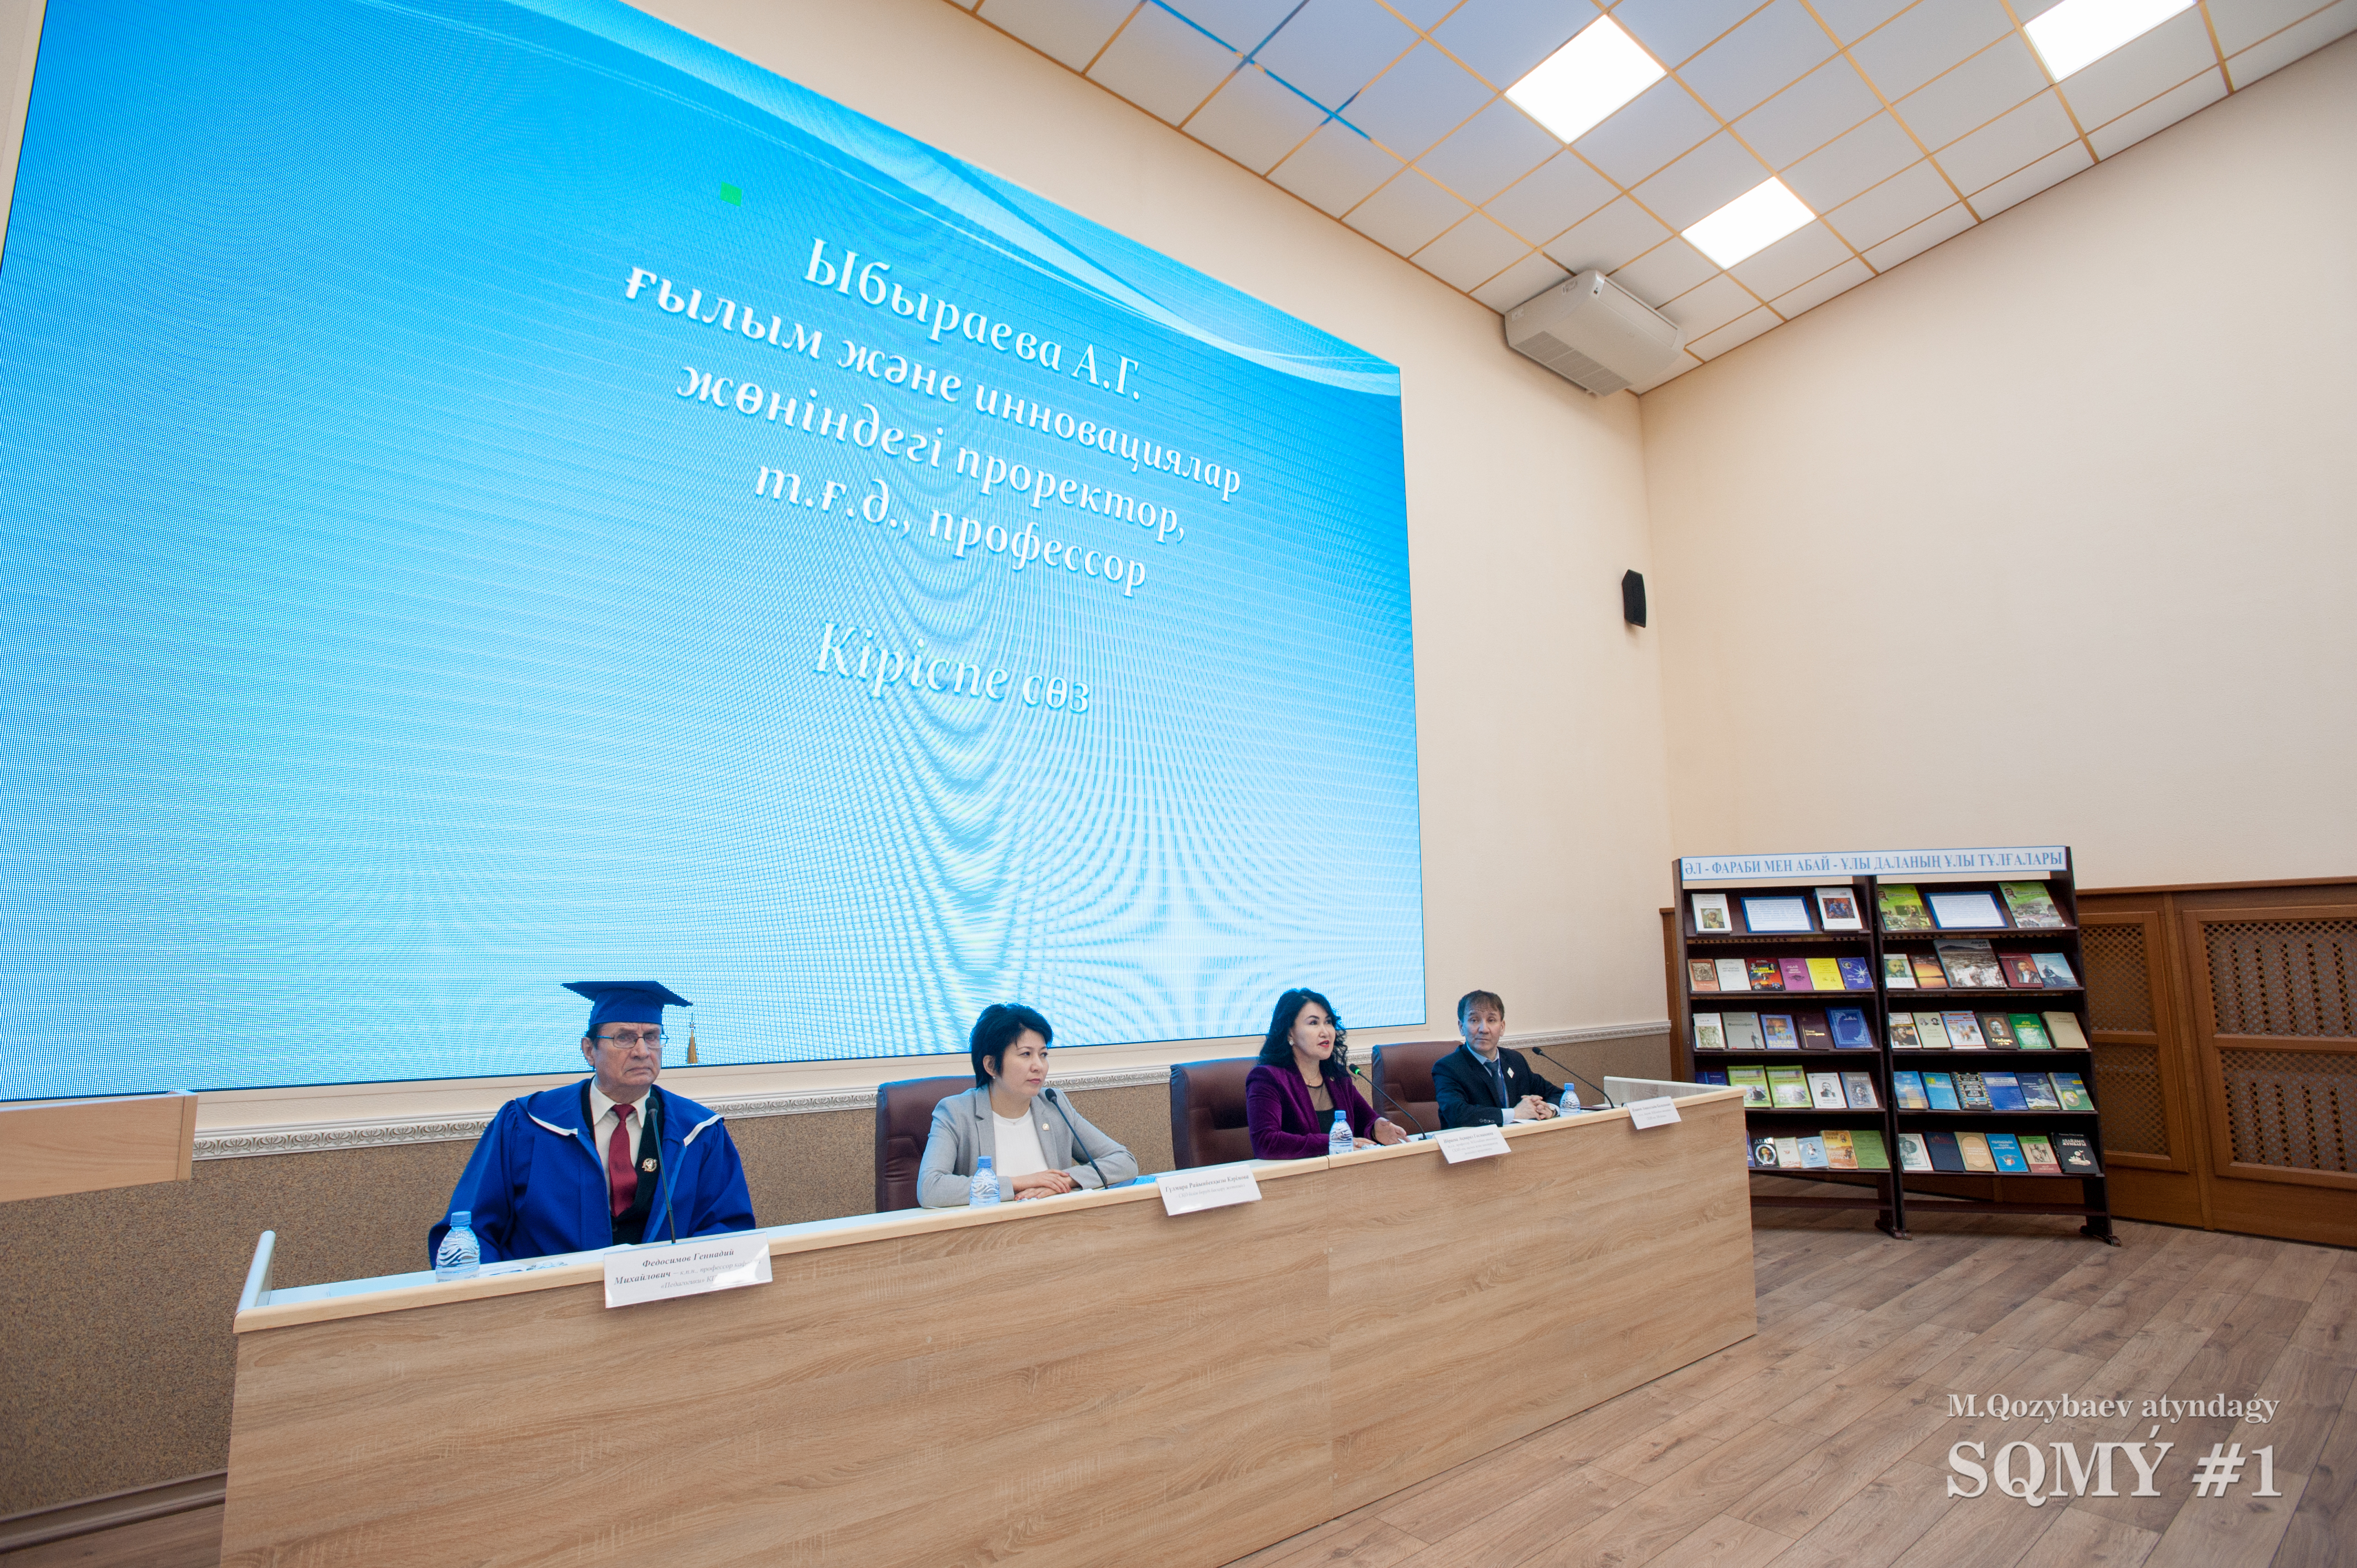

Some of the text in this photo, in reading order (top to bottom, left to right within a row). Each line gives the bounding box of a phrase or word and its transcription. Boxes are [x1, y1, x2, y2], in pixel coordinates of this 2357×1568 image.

[804, 237, 1141, 400] Ыбыраева А.Г.
[625, 267, 1241, 502] ғылым және инновациялар
[676, 367, 1185, 543] жөніндегі проректор,
[755, 466, 1146, 597] т.ғ.д., профессор
[814, 622, 1090, 714] Кіріспе сөз
[1685, 863, 1702, 875] ӘЛ
[1712, 860, 1761, 874] ФАРАБИ
[1764, 860, 1792, 873] МЕН
[1796, 856, 1830, 871] АБАЙ
[1841, 857, 1871, 870] ҰЛЫ
[1874, 855, 1942, 871] ДАЛАНЫҢ
[1944, 854, 1975, 868] ҰЛЫ
[1978, 852, 2062, 867] ТҰЛҒАЛАРЫ
[613, 1270, 671, 1286] Михайлович
[700, 1263, 733, 1273] профессор
[642, 1248, 734, 1268] Федосимов Геннадий
